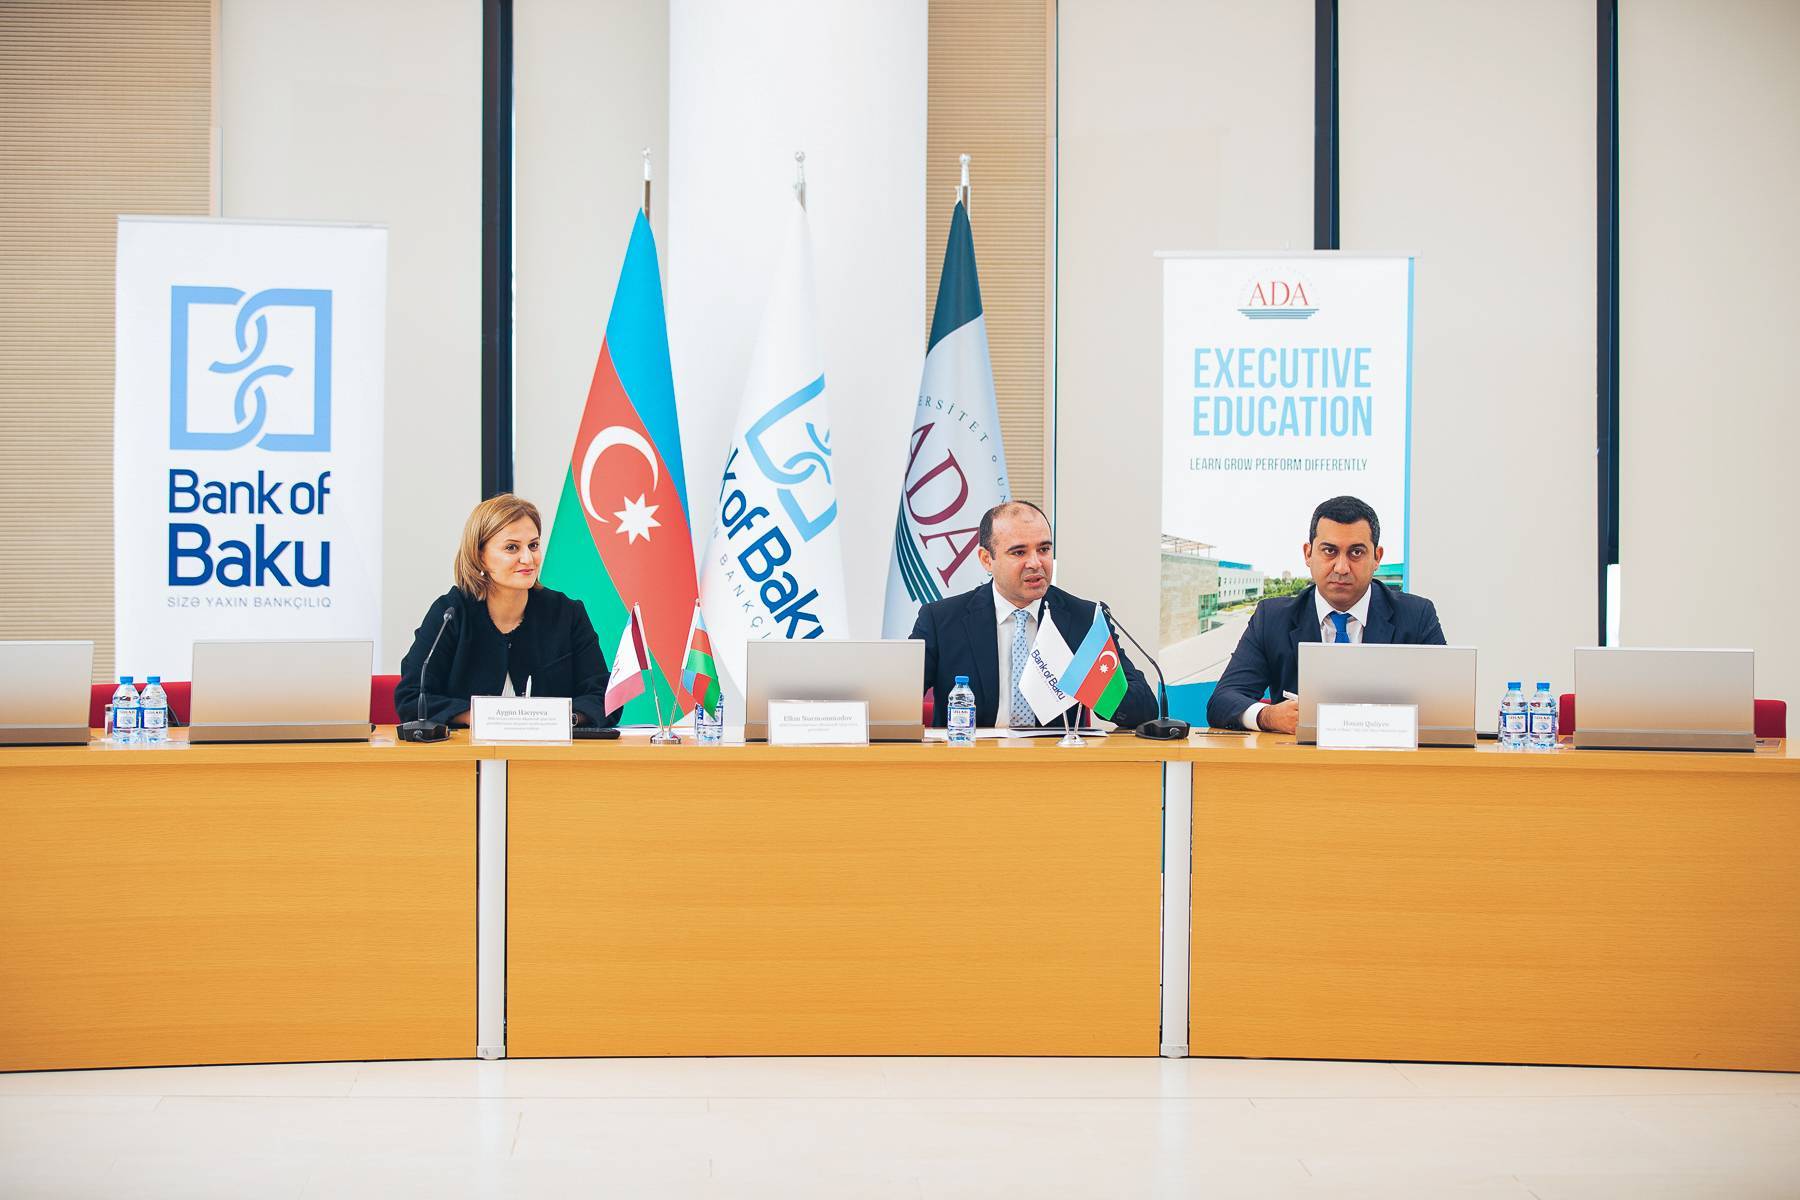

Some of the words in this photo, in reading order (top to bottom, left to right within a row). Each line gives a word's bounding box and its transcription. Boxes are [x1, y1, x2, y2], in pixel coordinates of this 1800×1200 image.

[1248, 281, 1310, 306] ADA
[1194, 347, 1372, 388] EXECUTIVE
[1193, 396, 1373, 436] EDUCATION
[1190, 458, 1221, 470] LEARN
[1224, 458, 1252, 471] GROW
[1256, 458, 1302, 471] PERFORM
[1305, 459, 1368, 471] DIFFERENTLY
[169, 468, 283, 514] Bank
[290, 470, 331, 515] of
[721, 489, 770, 541] of
[168, 523, 330, 587] Baku
[737, 525, 825, 640] Bak
[206, 596, 248, 608] YAXIN
[254, 596, 332, 610] BANKÇILIQ
[1031, 649, 1048, 672] Bank
[1043, 670, 1055, 679] of
[1048, 677, 1066, 700] Baku
